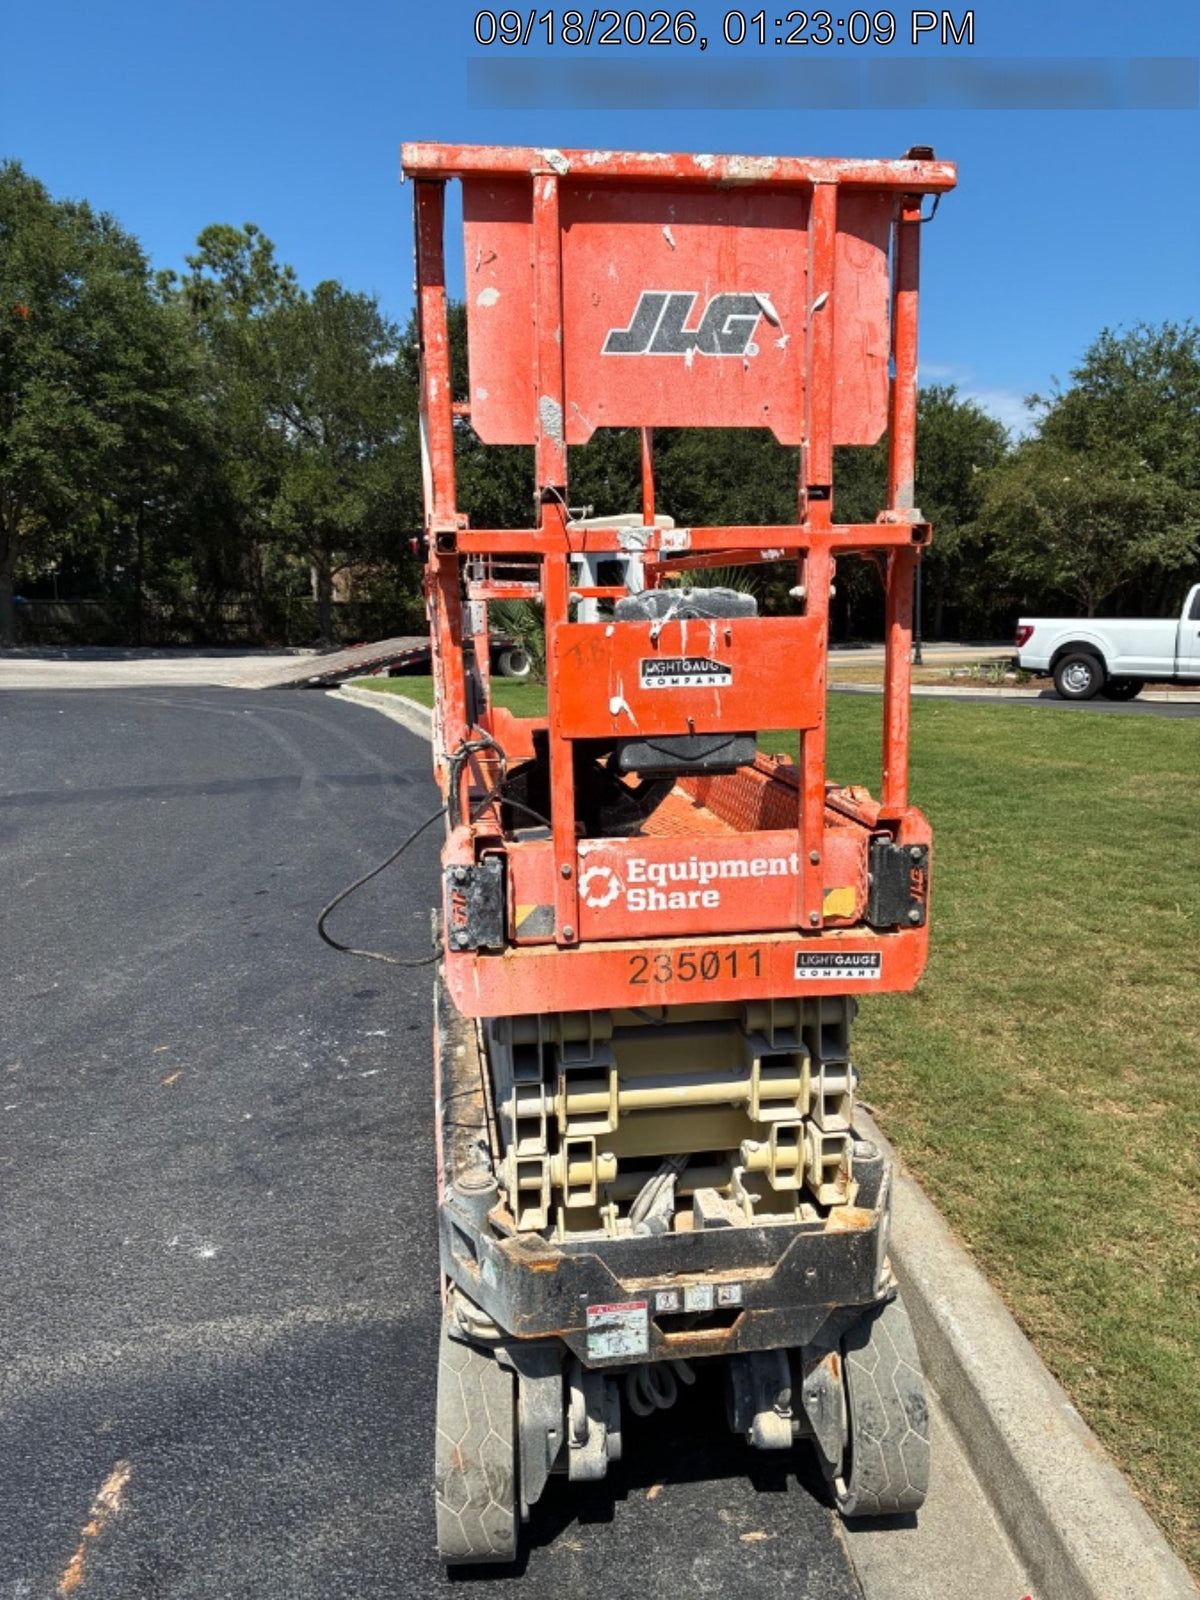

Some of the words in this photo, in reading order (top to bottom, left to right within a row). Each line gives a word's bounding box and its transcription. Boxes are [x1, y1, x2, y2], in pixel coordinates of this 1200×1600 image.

[600, 289, 770, 357] JLG
[645, 675, 727, 686] COMPANY
[626, 852, 799, 887] Equipment
[626, 887, 720, 912] Share
[629, 949, 761, 984] 235011
[801, 954, 877, 966] LIGHTGAUGE
[799, 969, 876, 977] COMPANY
